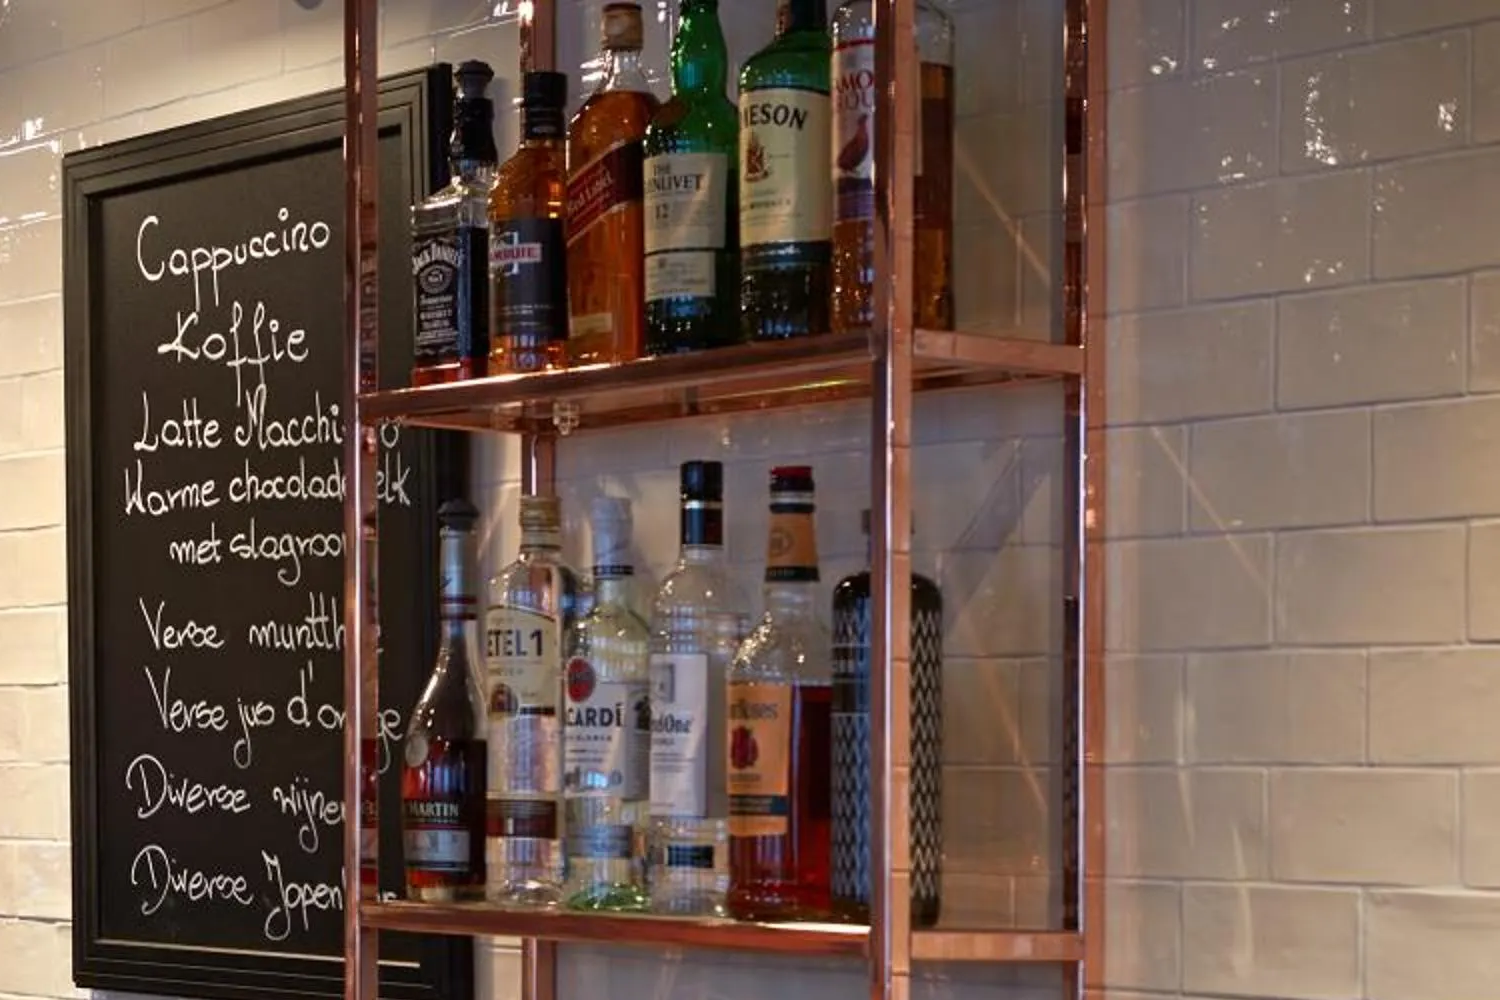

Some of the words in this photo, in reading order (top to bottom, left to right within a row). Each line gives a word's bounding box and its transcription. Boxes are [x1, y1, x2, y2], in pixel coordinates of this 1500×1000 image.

[645, 174, 706, 194] NLIVET
[137, 207, 330, 311] Cappuccino
[157, 301, 309, 407] Koffie
[134, 391, 222, 451] Latte
[235, 383, 399, 450] Macchio
[124, 458, 221, 515] Warme
[229, 452, 412, 505] chocoladelk
[169, 522, 221, 564] met
[229, 517, 346, 585] slagroo
[140, 597, 224, 650] Verse
[249, 591, 382, 653] muntth
[487, 629, 527, 657] ETEL
[145, 666, 228, 732] Verse
[233, 697, 275, 769] jus
[287, 659, 403, 775] d'orge
[566, 703, 623, 728] CARDÍ
[125, 753, 250, 819] Diverse
[273, 777, 346, 853] wijne
[408, 802, 459, 817] MARTIN
[131, 844, 253, 916] Diverse
